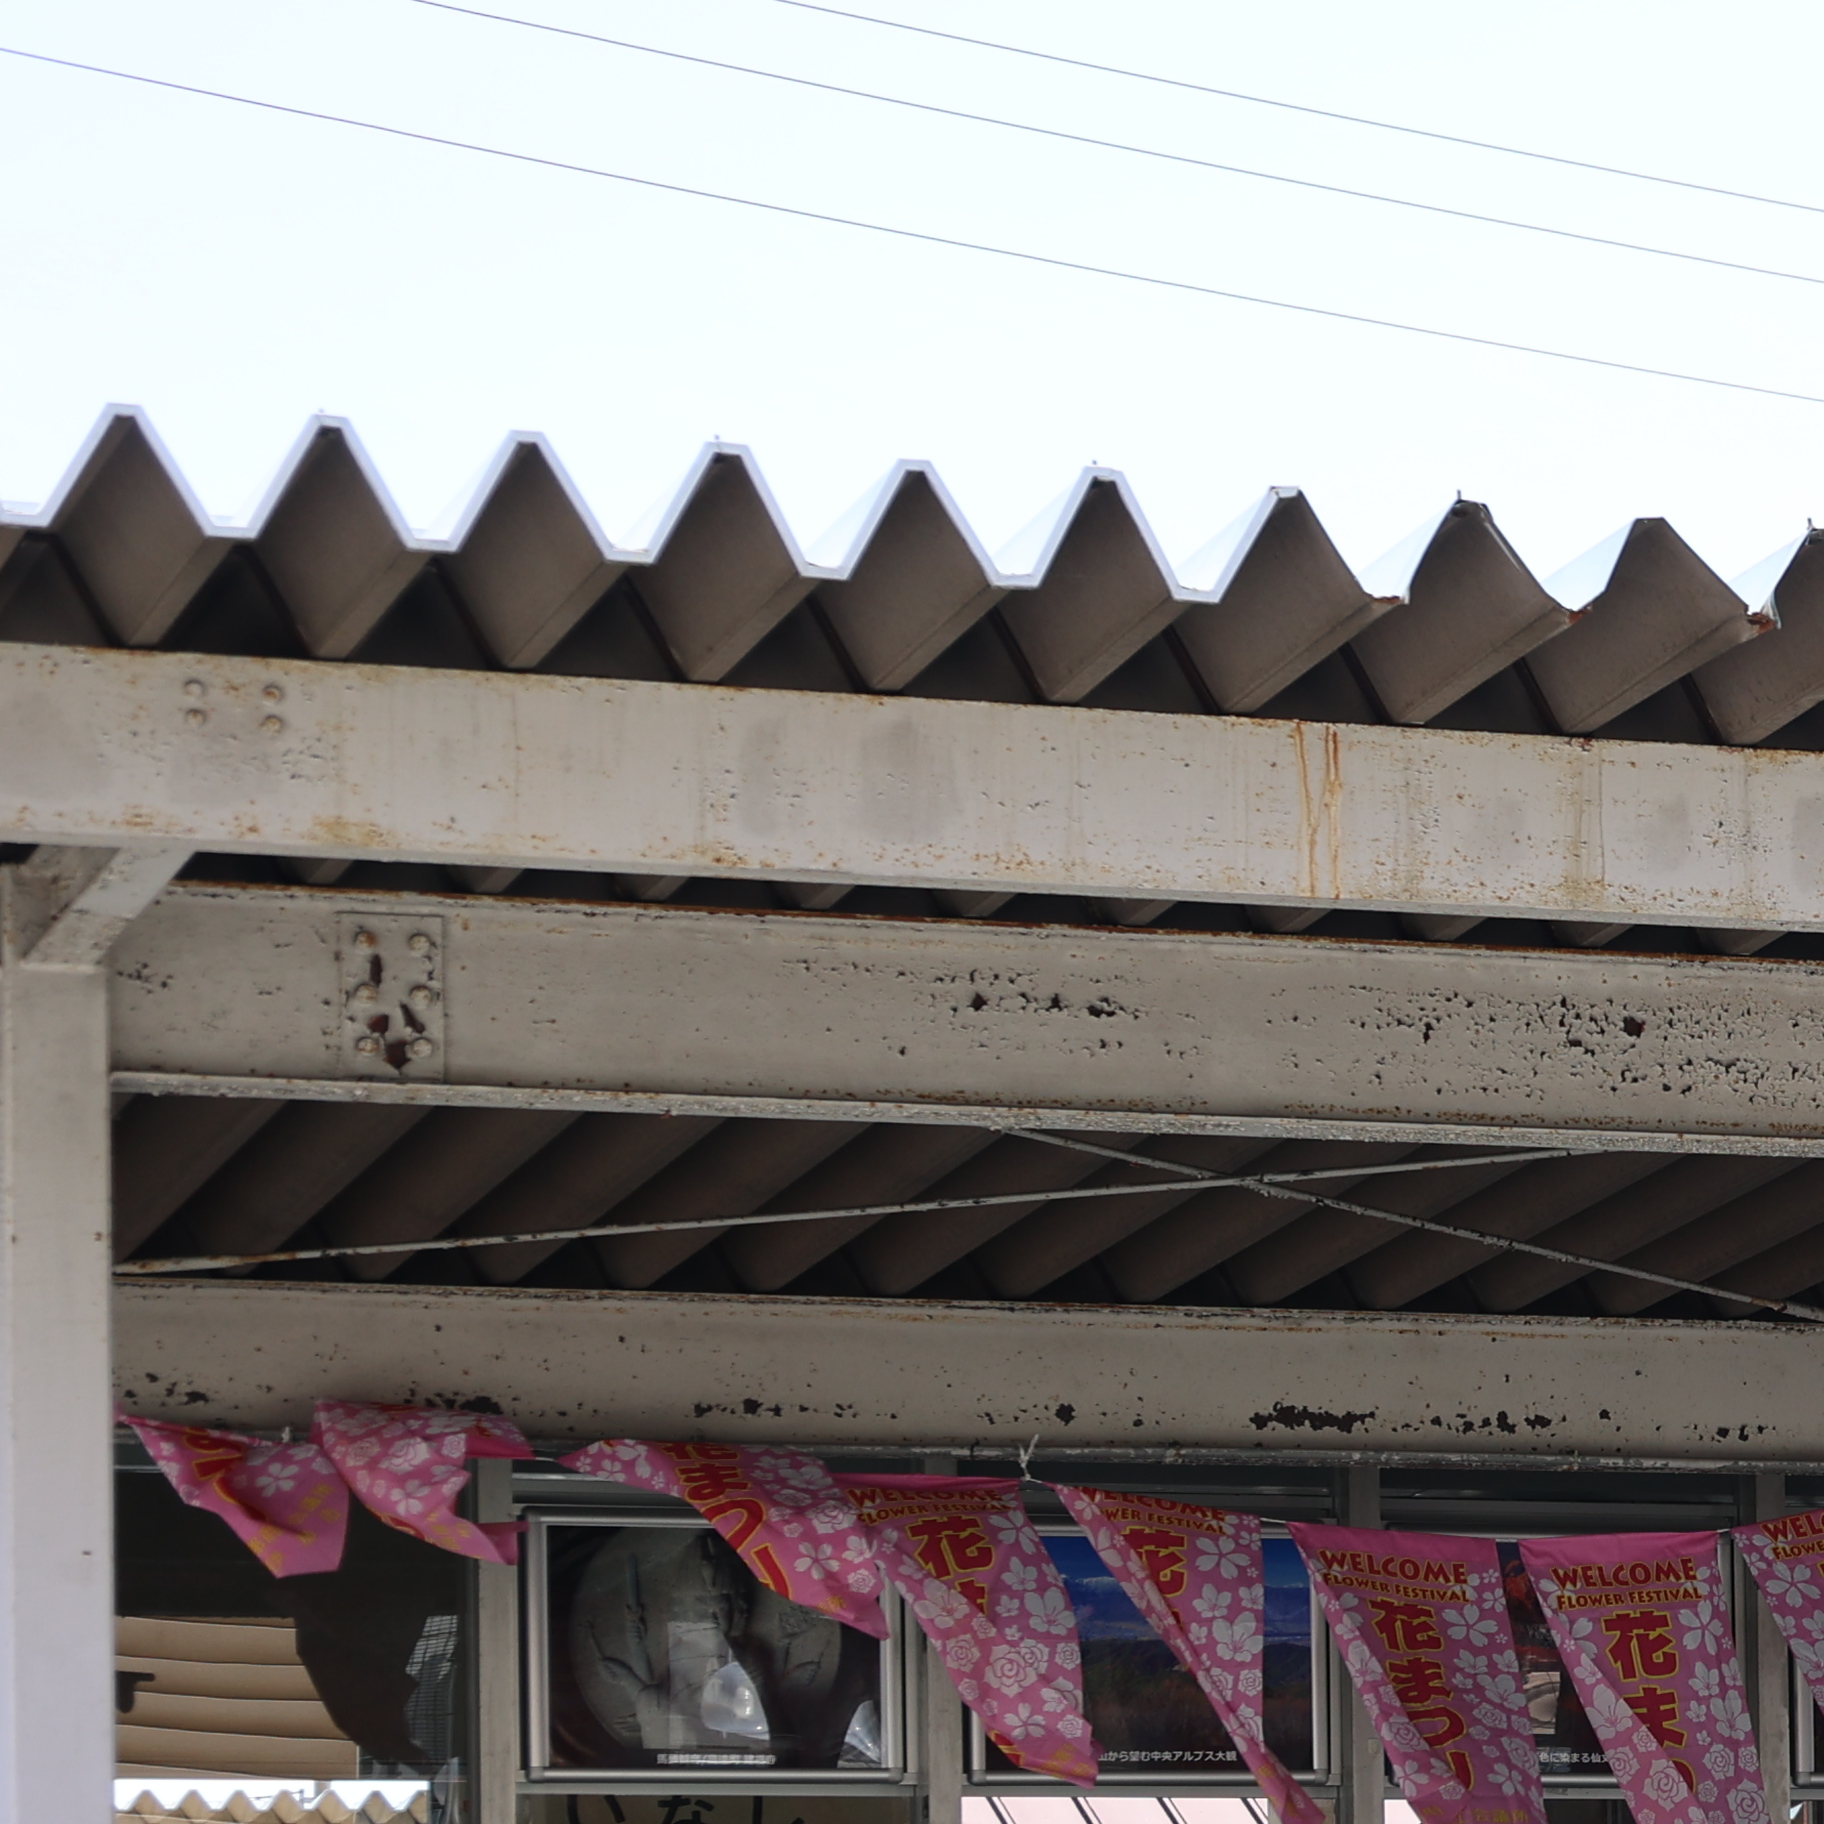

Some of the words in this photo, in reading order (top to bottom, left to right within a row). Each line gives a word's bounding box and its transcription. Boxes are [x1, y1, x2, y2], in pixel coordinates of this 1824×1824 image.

[857, 1504, 930, 1526] FLOWER
[1148, 1512, 1227, 1536] FESTIVAL
[1318, 1550, 1469, 1585] WELCOME
[1549, 1556, 1699, 1592] WELCOME
[1322, 1572, 1391, 1595] FLOWER
[1394, 1585, 1471, 1604] FESTIVAL
[1556, 1592, 1626, 1611] FLOWER
[1628, 1586, 1703, 1606] FESTIVAL
